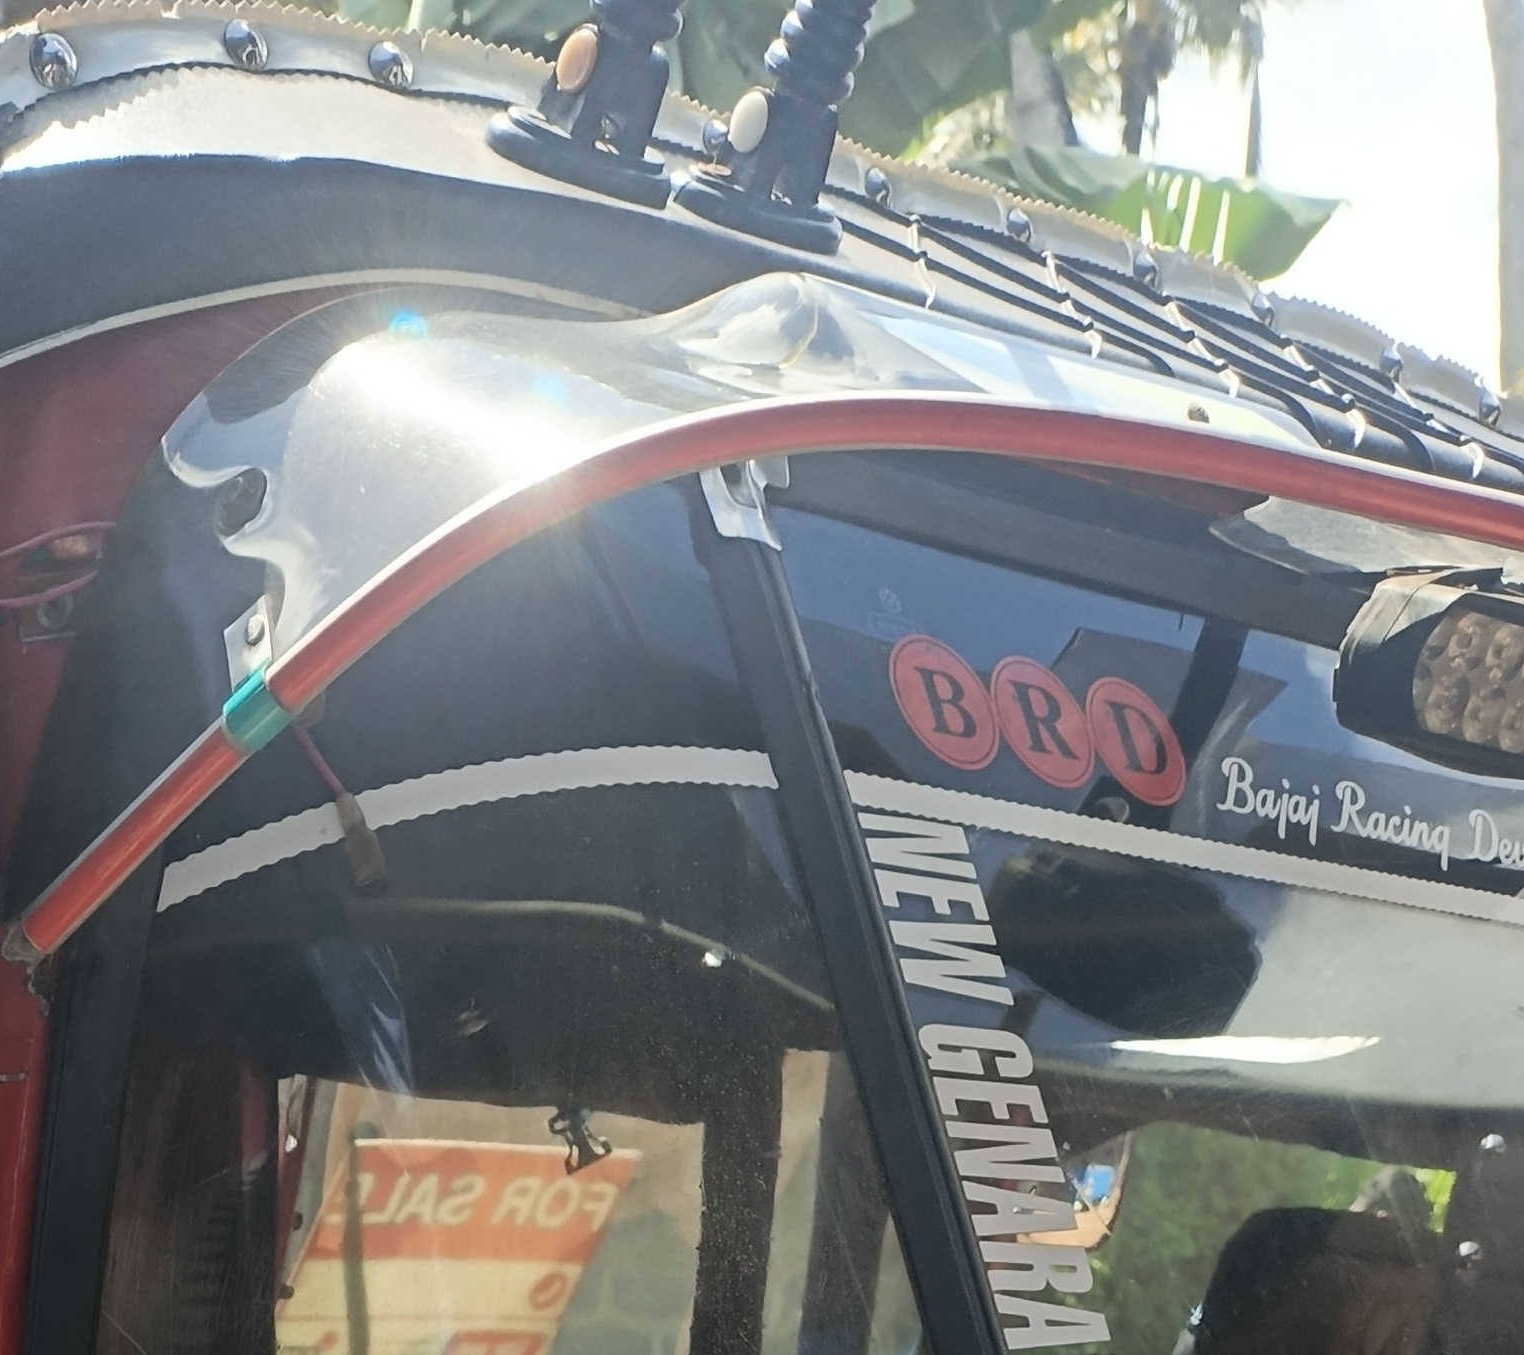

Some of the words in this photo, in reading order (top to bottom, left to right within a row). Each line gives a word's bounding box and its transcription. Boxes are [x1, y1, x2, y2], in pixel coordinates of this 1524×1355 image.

[912, 664, 1168, 776] BRD
[1216, 756, 1320, 846] Bajaj
[1330, 780, 1451, 872] Racing
[857, 812, 1016, 1006] NEW
